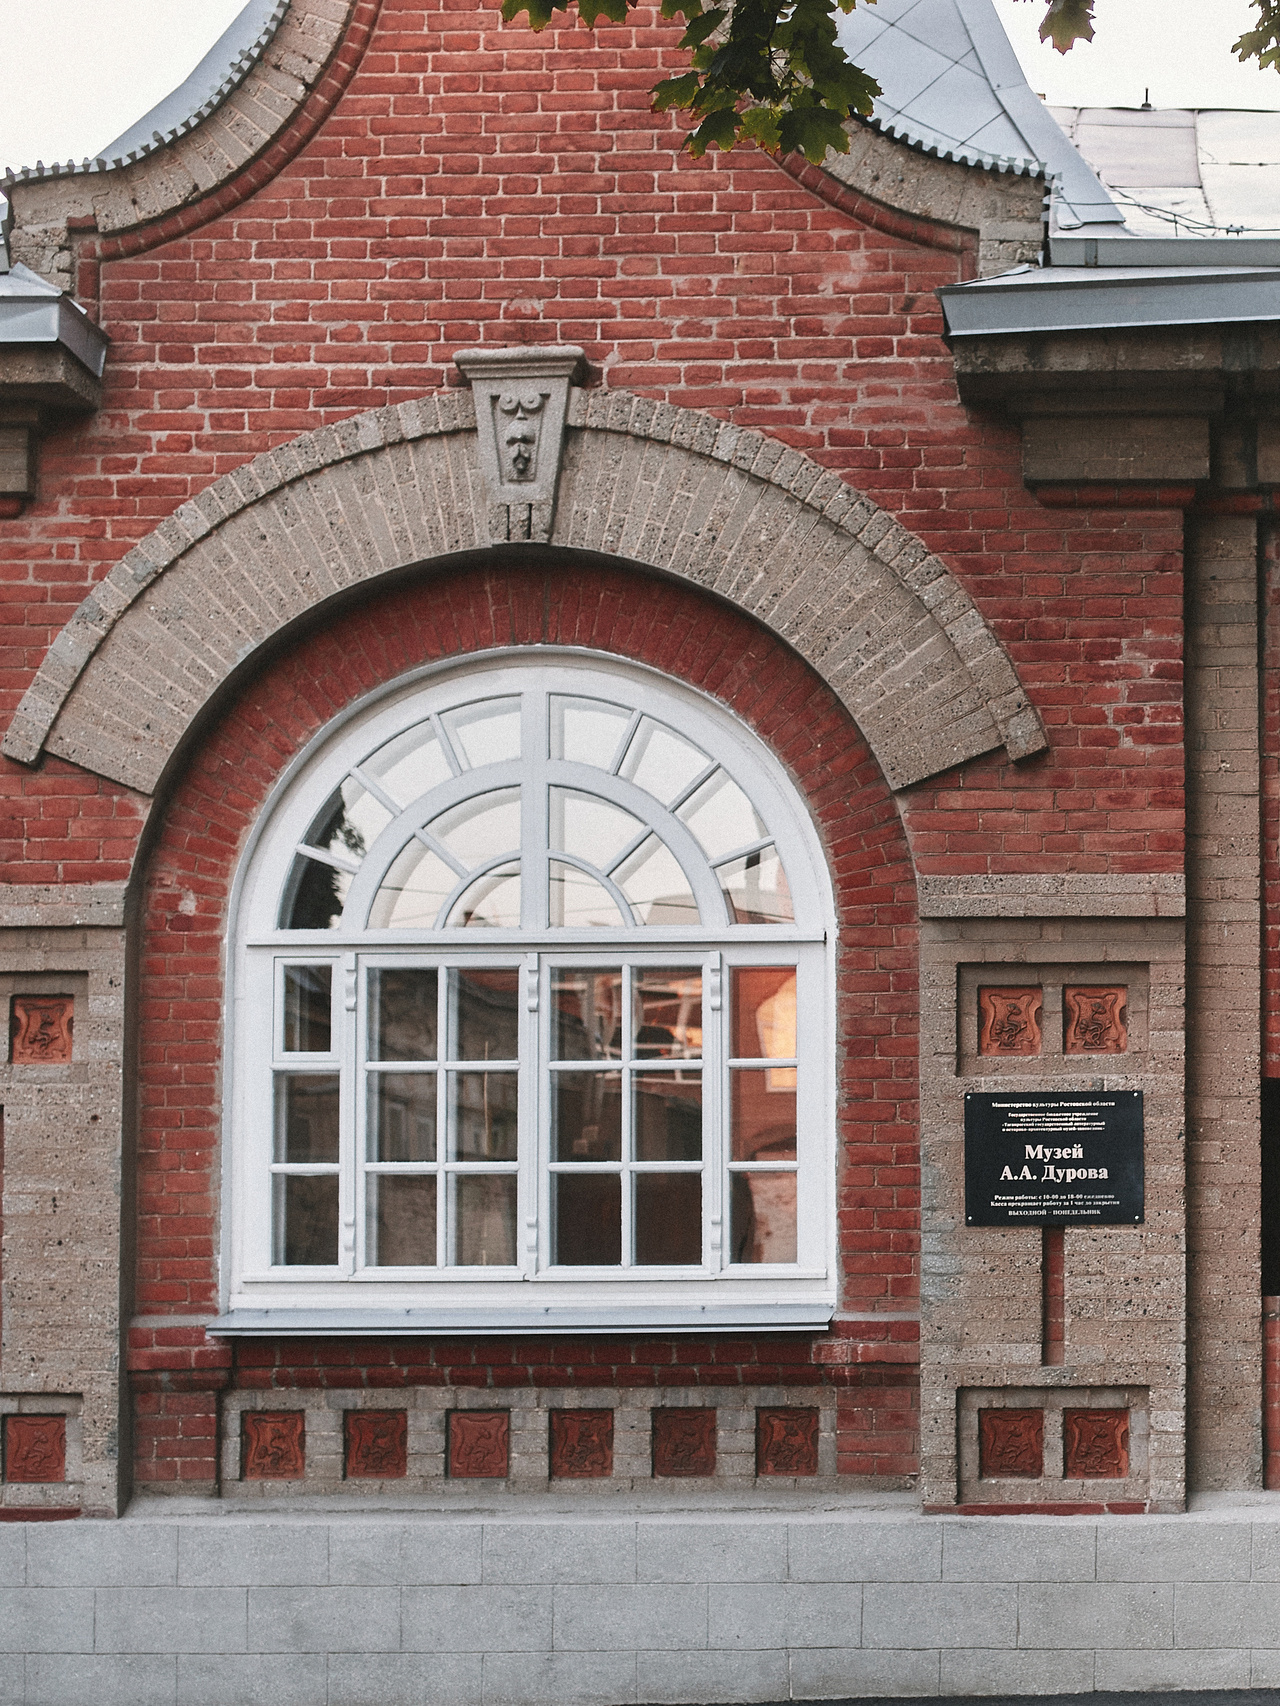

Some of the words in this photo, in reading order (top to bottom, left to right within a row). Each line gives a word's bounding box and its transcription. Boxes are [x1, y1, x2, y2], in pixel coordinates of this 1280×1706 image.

[1025, 1144, 1083, 1162] Музей
[1000, 1165, 1037, 1180] А.А.
[1041, 1165, 1108, 1183] Дурова
